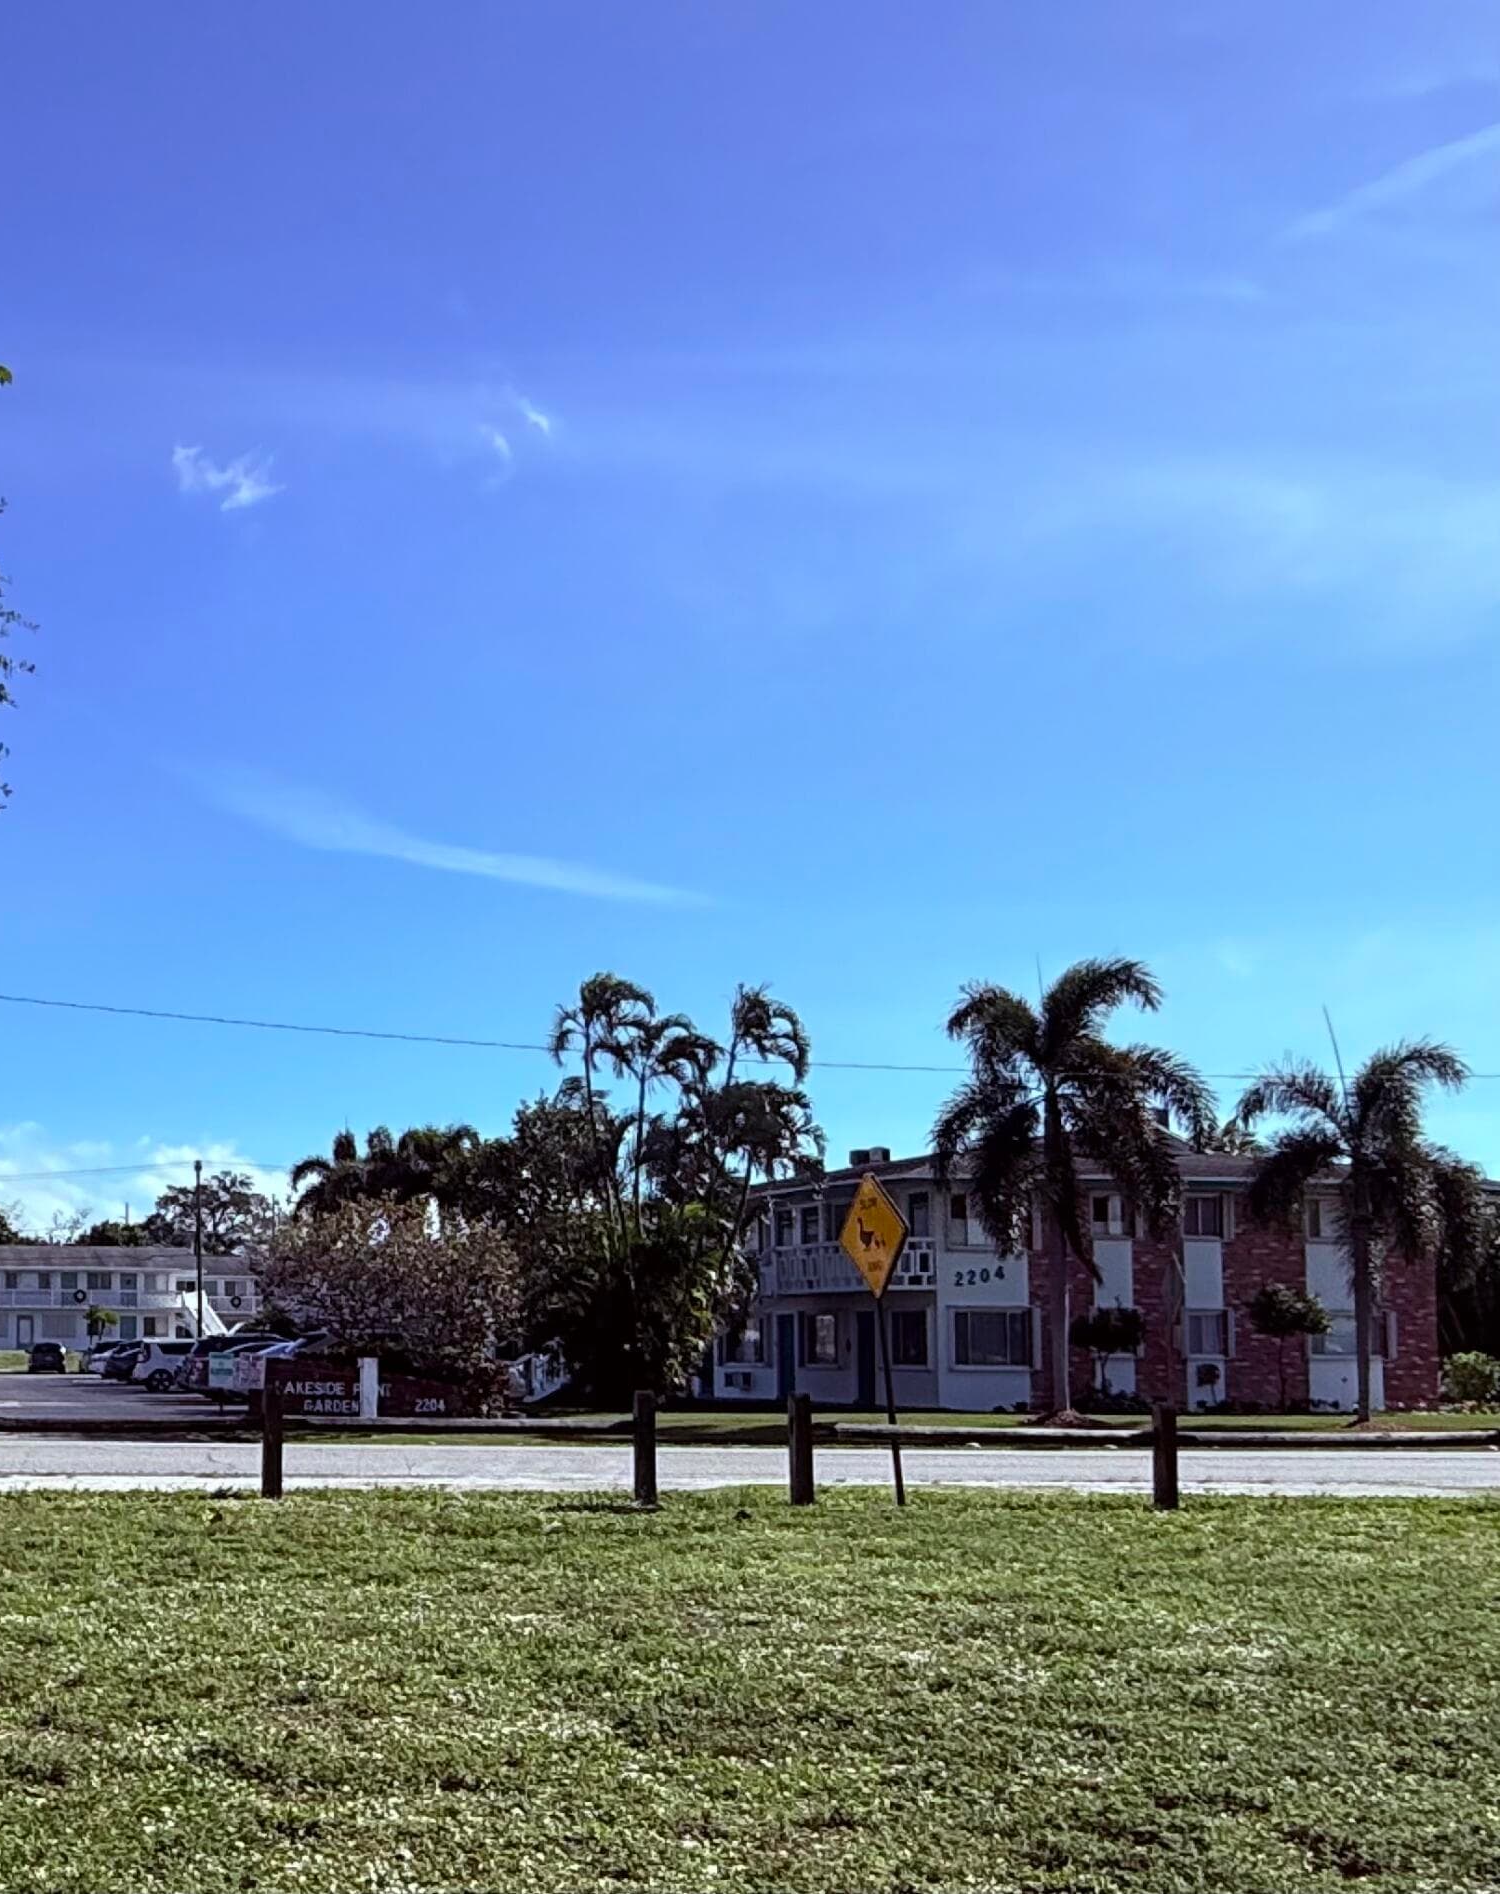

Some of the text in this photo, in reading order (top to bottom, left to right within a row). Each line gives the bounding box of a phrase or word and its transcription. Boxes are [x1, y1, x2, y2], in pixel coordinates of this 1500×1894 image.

[954, 1265, 1005, 1287] 2204
[303, 1399, 361, 1413] GARDEN
[414, 1398, 446, 1412] 2204
